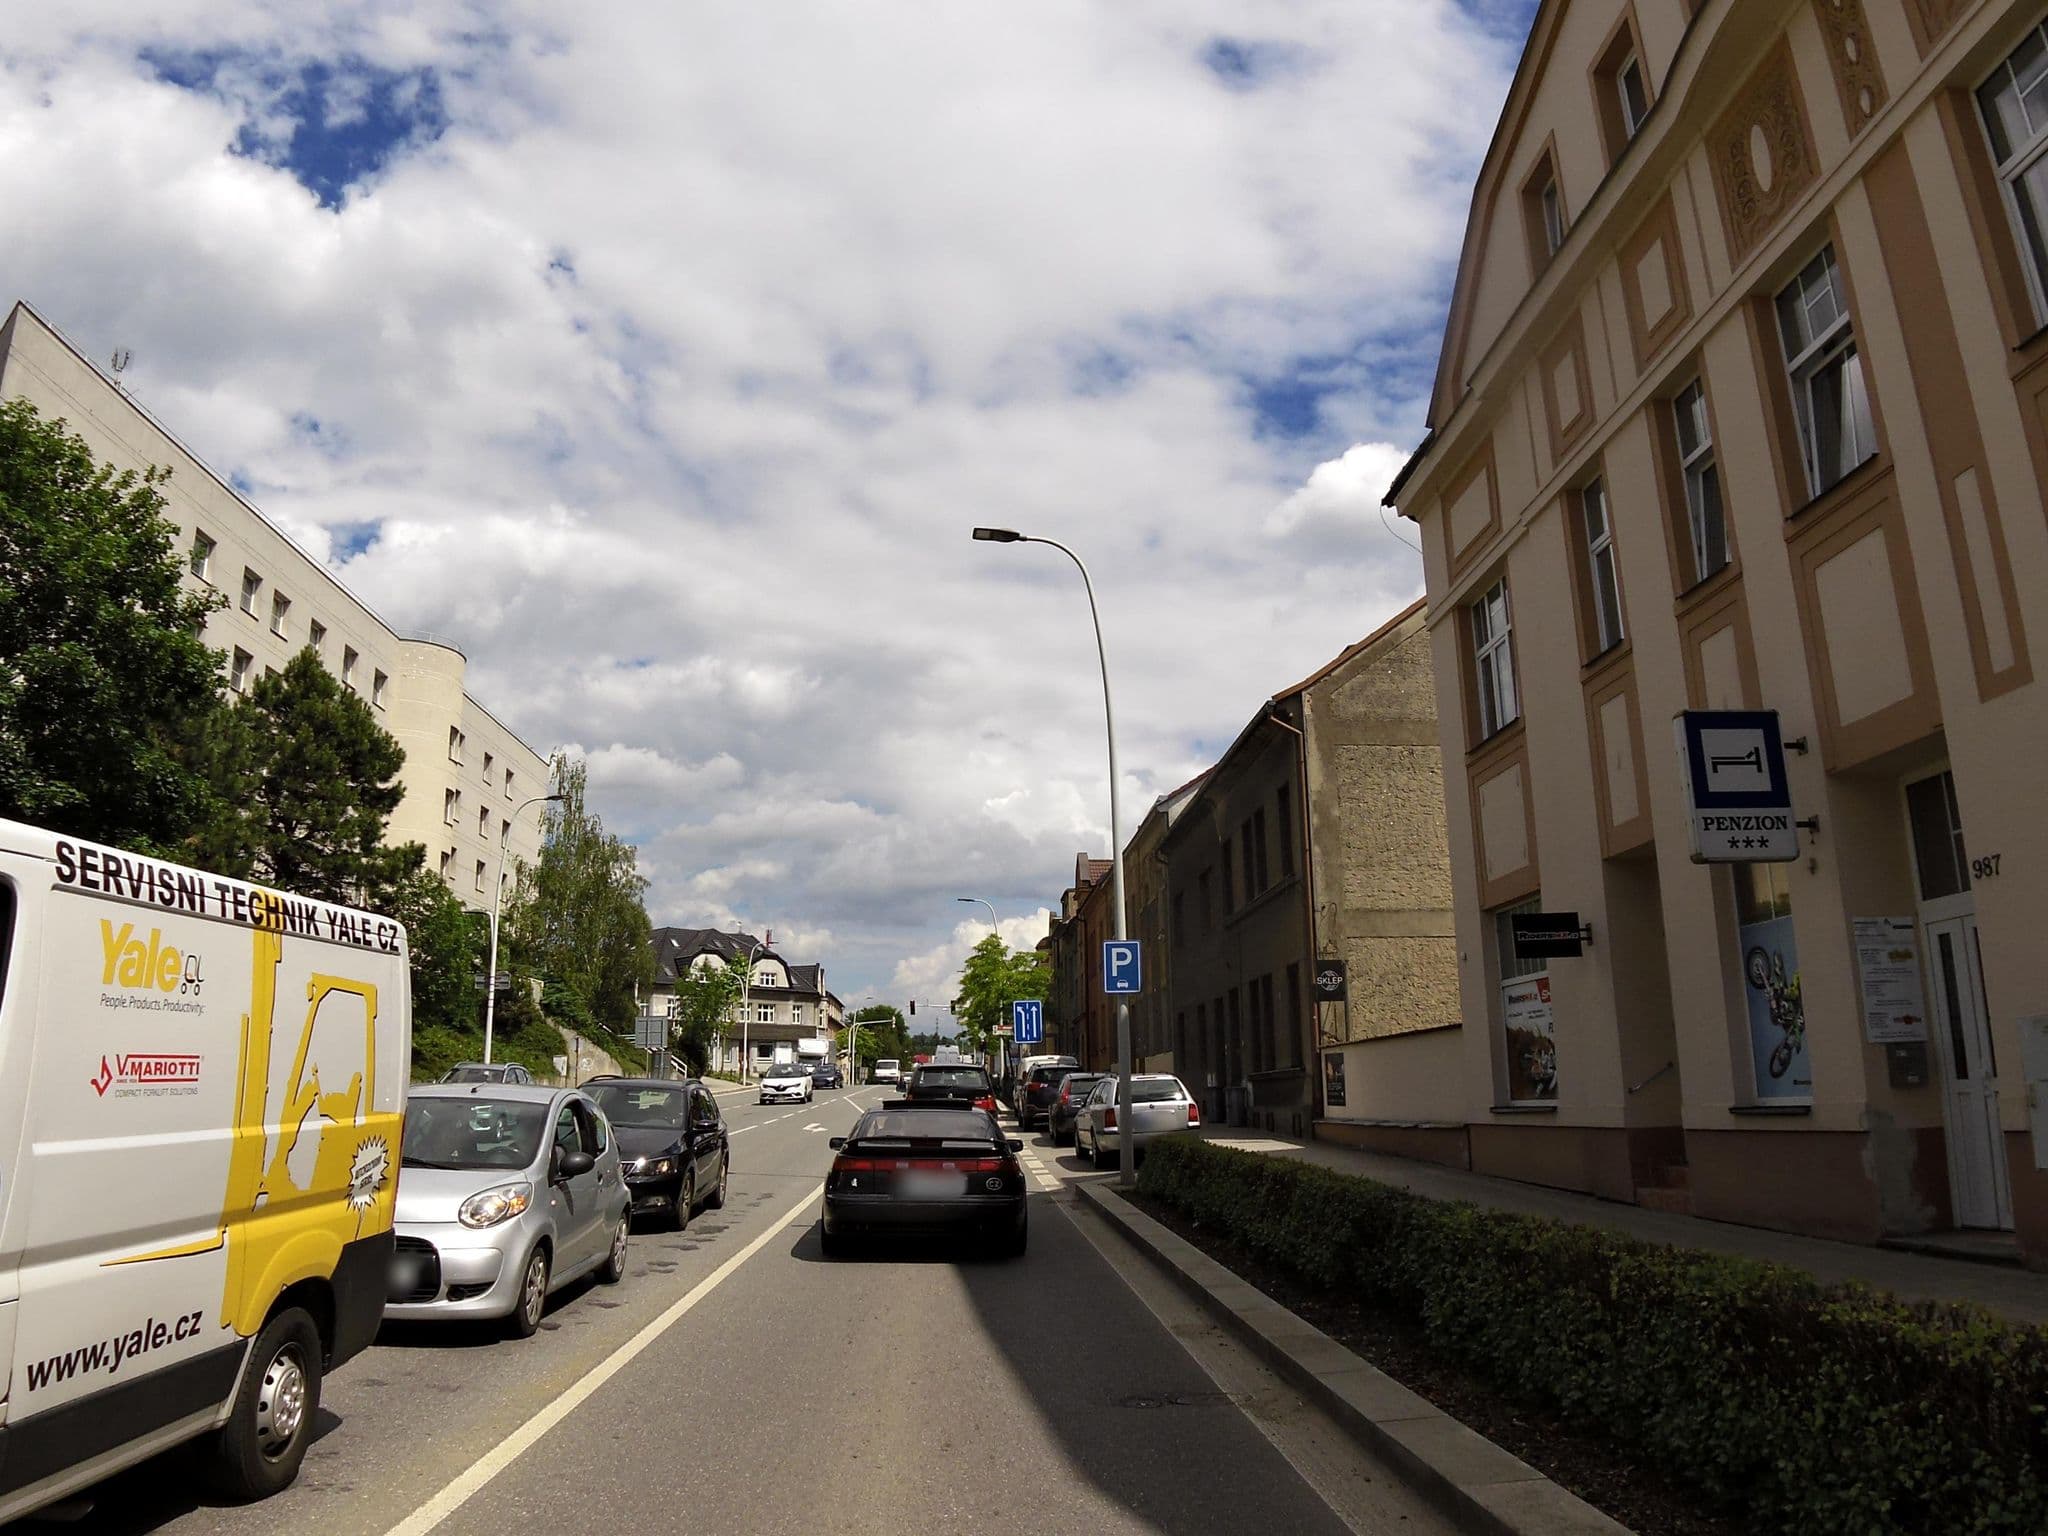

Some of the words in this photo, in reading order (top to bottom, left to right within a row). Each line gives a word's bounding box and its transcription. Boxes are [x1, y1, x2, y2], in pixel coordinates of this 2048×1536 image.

[1703, 815, 1788, 832] PENZION
[1972, 853, 2002, 881] 987
[215, 881, 321, 937] TECHNIK
[325, 911, 373, 947] YALE
[377, 923, 400, 952] CZ
[100, 919, 182, 993] Yale
[1111, 947, 1133, 977] P
[1316, 976, 1343, 985] SKLEP
[116, 1054, 200, 1077] V.MARIOTTI
[27, 1311, 203, 1392] www.yale.cz
